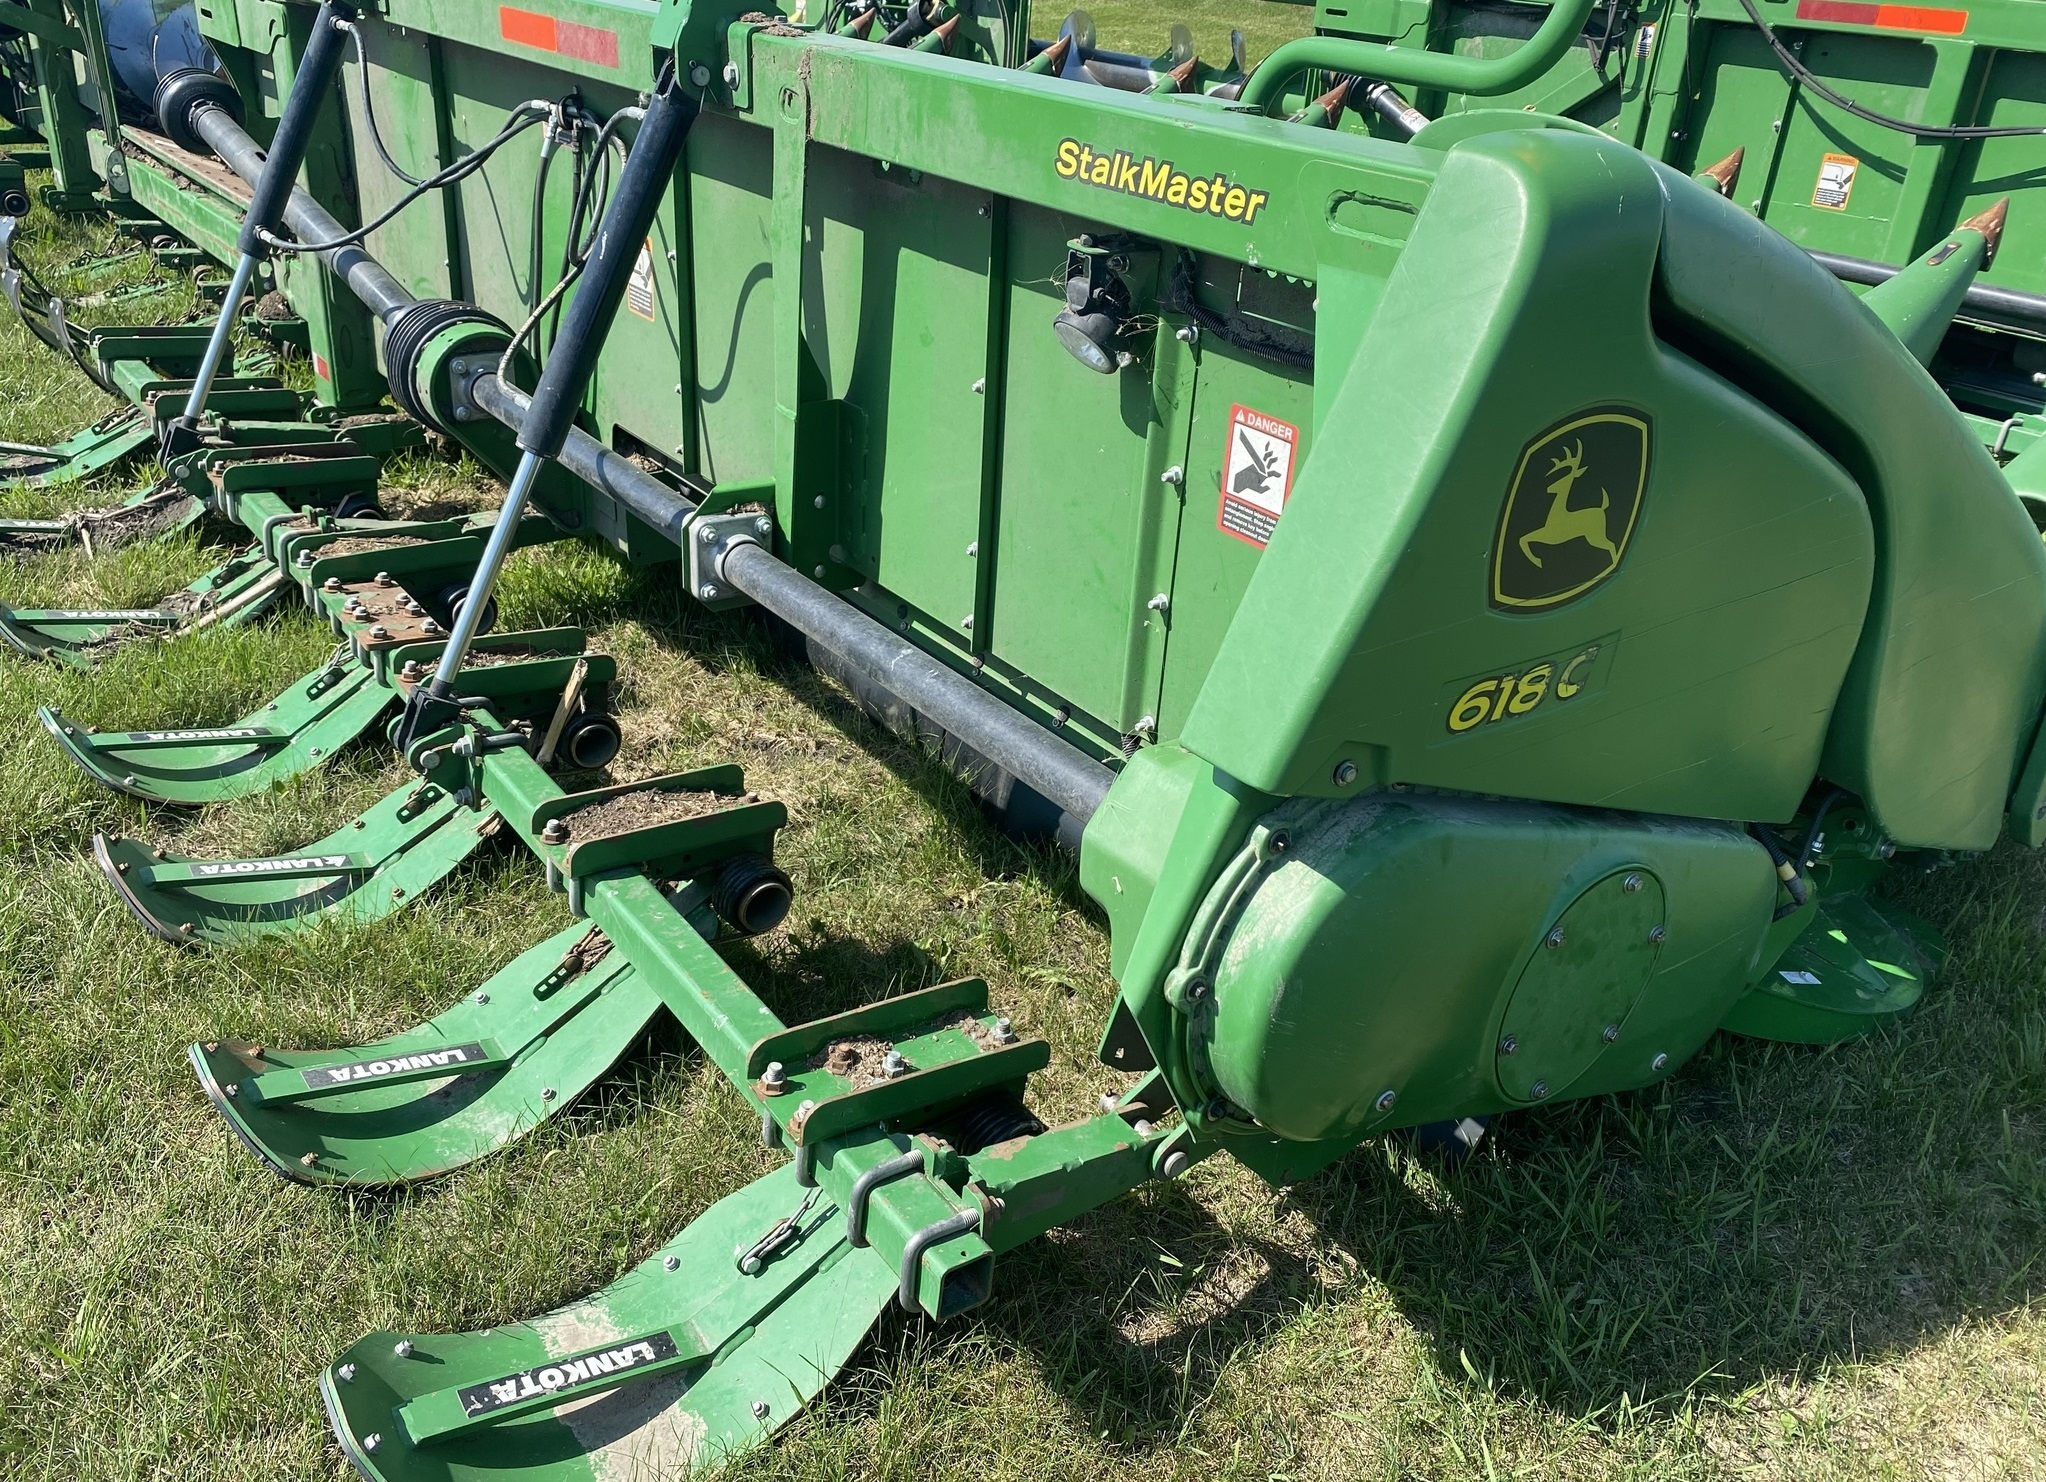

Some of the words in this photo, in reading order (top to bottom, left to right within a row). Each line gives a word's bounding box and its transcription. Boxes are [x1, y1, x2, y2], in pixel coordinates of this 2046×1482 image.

[1055, 140, 1266, 222] StalkMaster
[1247, 412, 1293, 441] DANGER
[1448, 663, 1552, 732] 618
[147, 729, 257, 741] LANKOTA
[199, 856, 324, 875] LANKOTA
[328, 1048, 467, 1083] LANKOTA
[489, 1341, 656, 1404] LANKOTA
